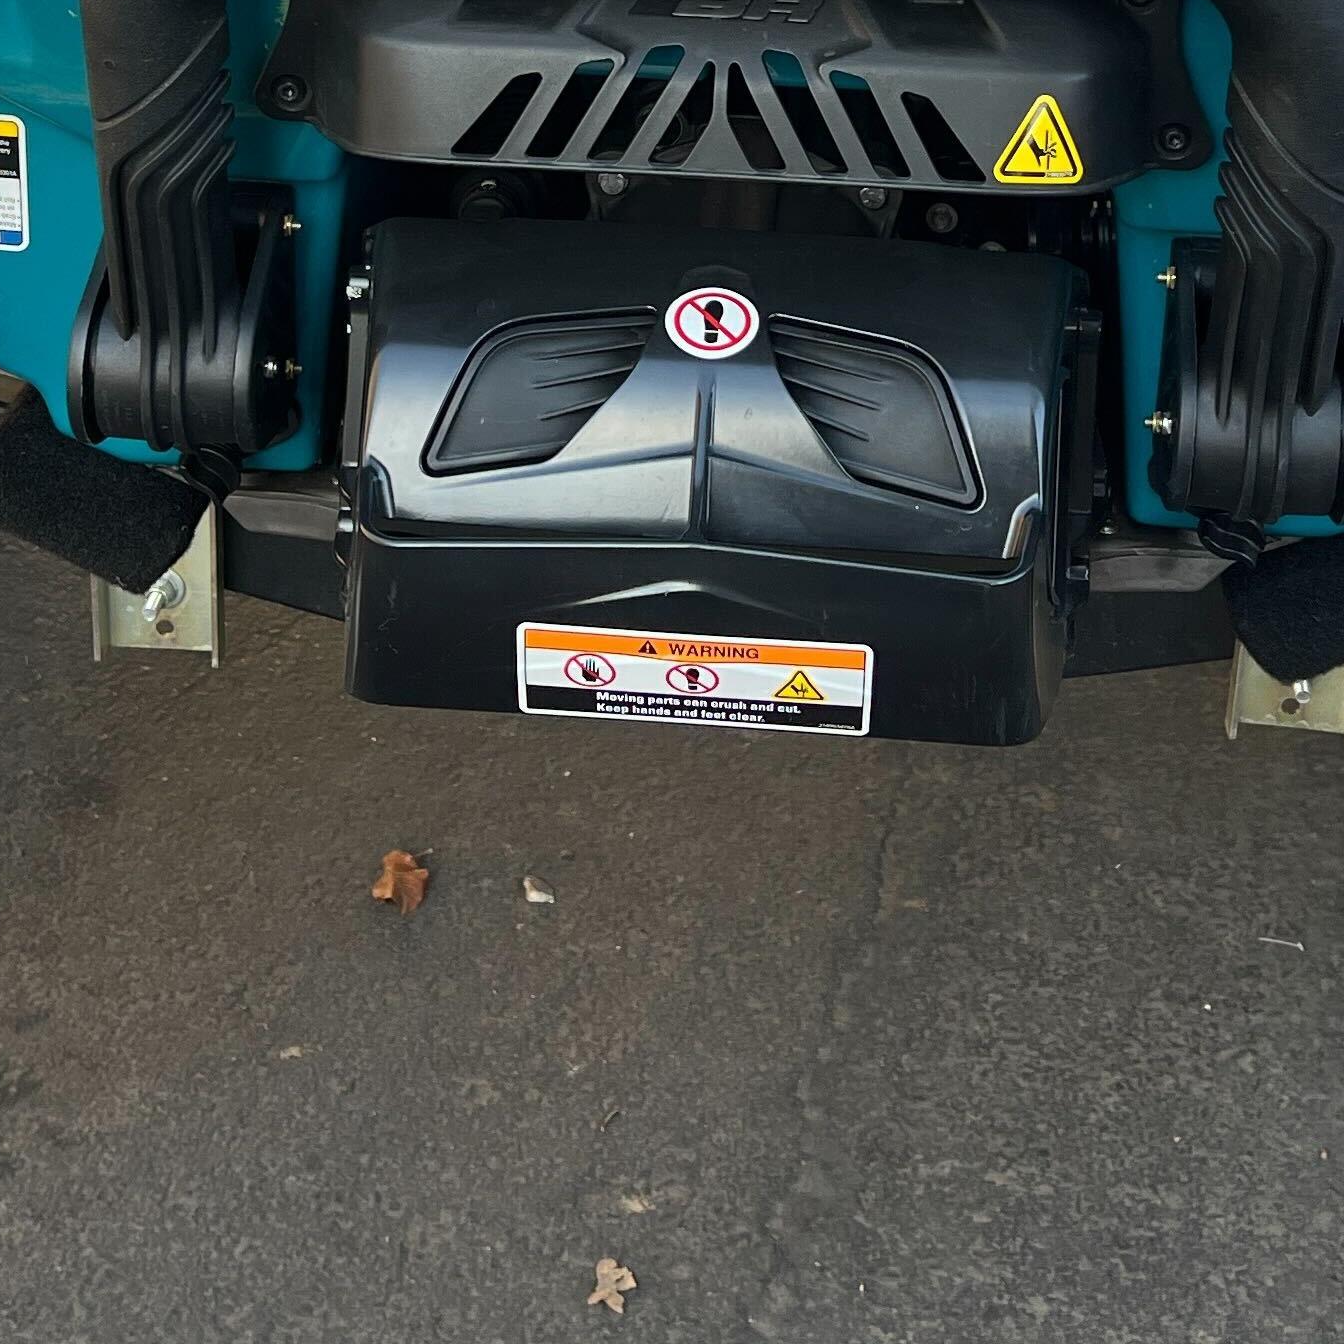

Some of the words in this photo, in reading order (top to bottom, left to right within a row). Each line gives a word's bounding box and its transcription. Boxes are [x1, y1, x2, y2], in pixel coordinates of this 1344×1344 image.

[669, 643, 759, 659] WARNING
[594, 702, 631, 715] Keep
[630, 704, 671, 717] hands
[673, 707, 698, 718] and
[700, 709, 726, 720] feet
[596, 692, 644, 706] Moving
[647, 696, 680, 707] parts
[683, 698, 707, 709] can
[710, 700, 747, 711] crush
[750, 702, 774, 713] and
